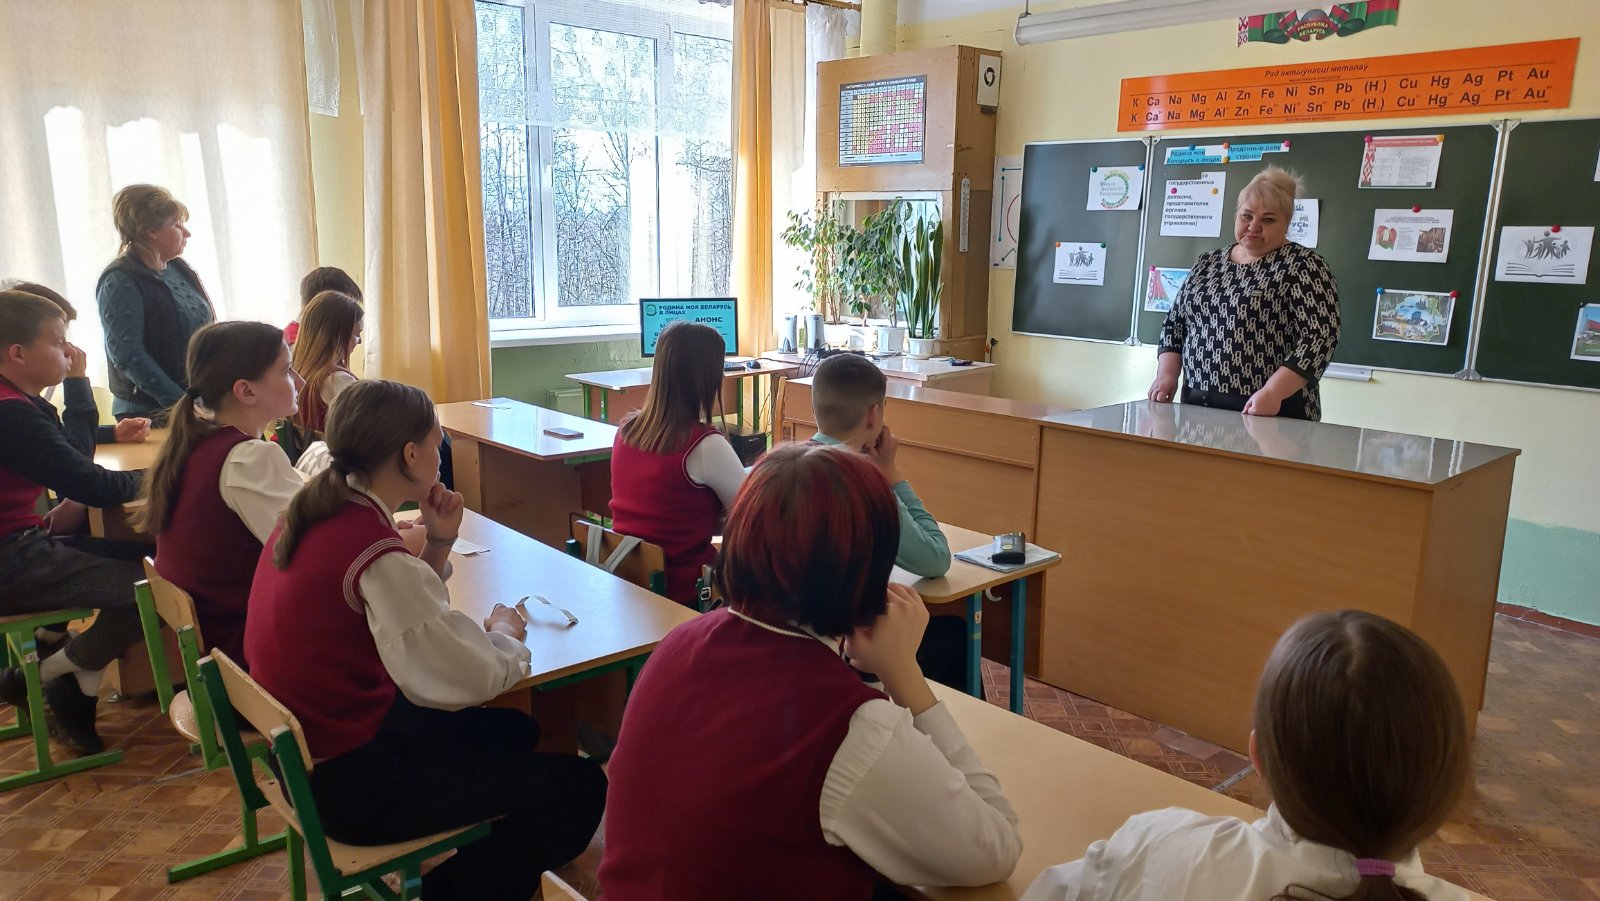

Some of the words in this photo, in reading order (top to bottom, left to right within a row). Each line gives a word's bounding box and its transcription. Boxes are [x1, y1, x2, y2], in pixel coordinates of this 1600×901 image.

[1265, 70, 1279, 78] Рад
[1132, 98, 1139, 107] K
[1146, 96, 1160, 106] Ca
[1169, 96, 1182, 105] Na
[1192, 94, 1206, 105] Mg
[1216, 92, 1227, 101] Al
[1236, 90, 1250, 100] Zn
[1261, 89, 1275, 98] Fe
[1286, 87, 1298, 97] Ni
[1309, 85, 1324, 95] Sn
[1336, 83, 1352, 93] Pb
[1400, 78, 1417, 88] Cu
[1431, 76, 1450, 88] Hg
[1463, 73, 1483, 86] Ag
[1497, 70, 1514, 82] Pt
[1527, 68, 1549, 79] Au
